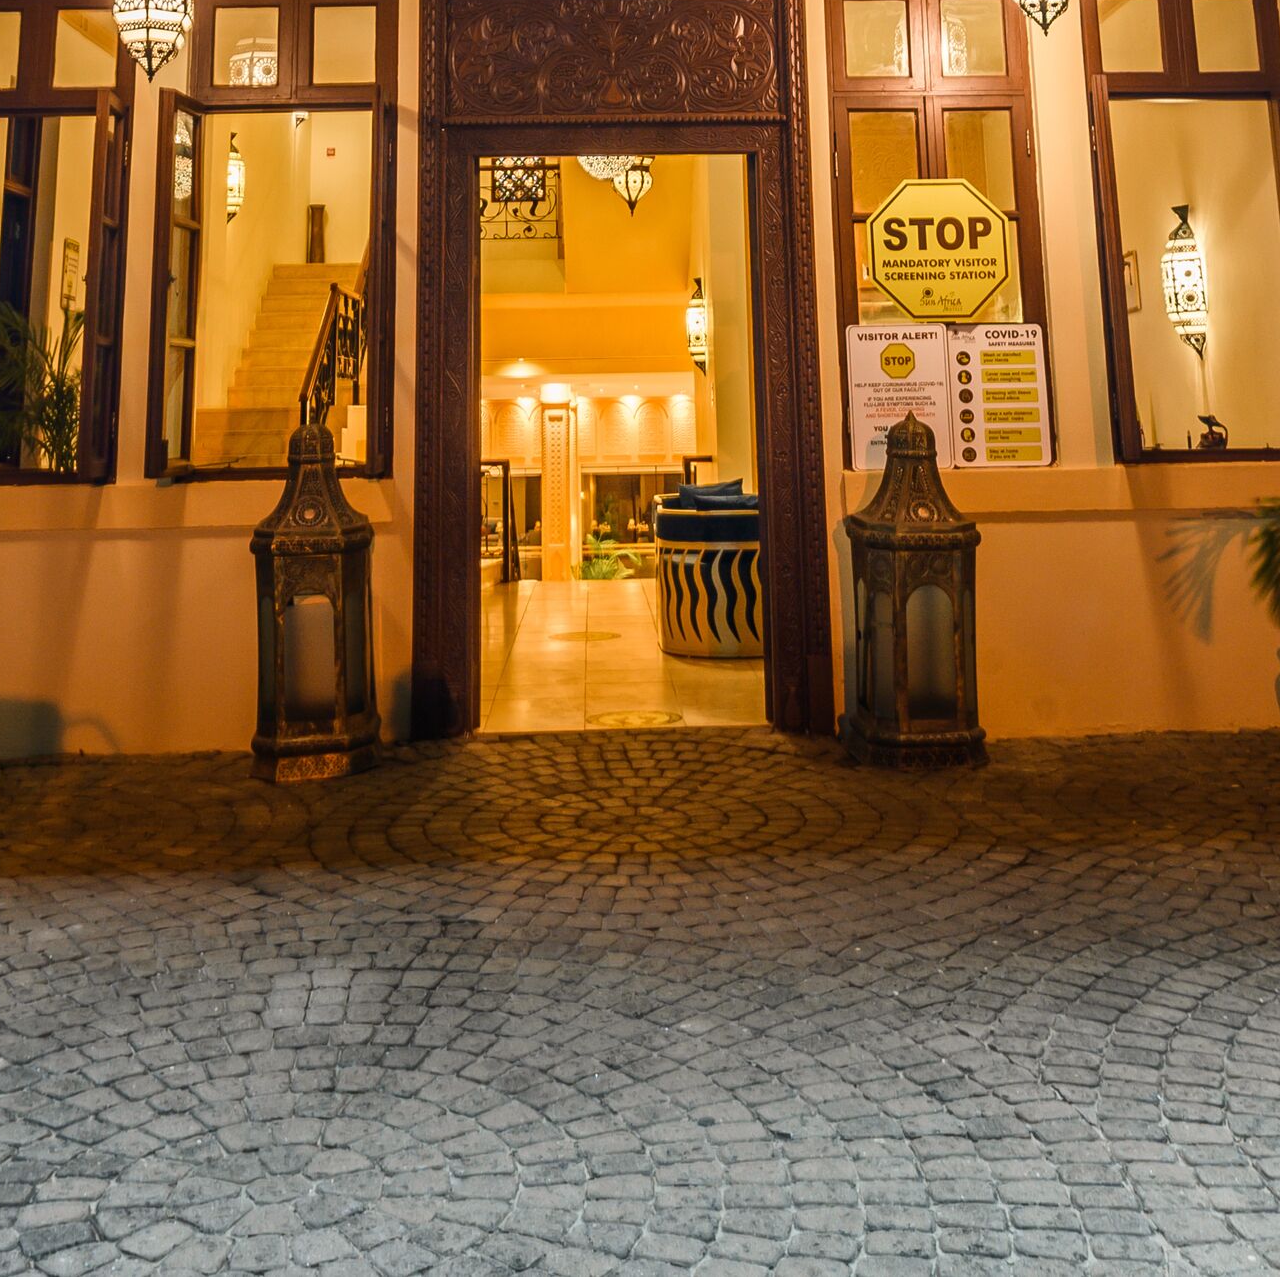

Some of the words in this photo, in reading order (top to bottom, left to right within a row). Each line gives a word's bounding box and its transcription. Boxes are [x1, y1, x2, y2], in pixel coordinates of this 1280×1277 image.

[883, 217, 992, 251] STOP
[882, 259, 950, 268] MANDATORY
[955, 258, 997, 267] VISITOR
[884, 272, 946, 281] SCREENING
[950, 271, 996, 280] STATION
[857, 333, 898, 341] VISITOR
[902, 332, 938, 340] ALERT!
[985, 330, 1037, 339] COVID-19
[884, 357, 911, 366] STOP
